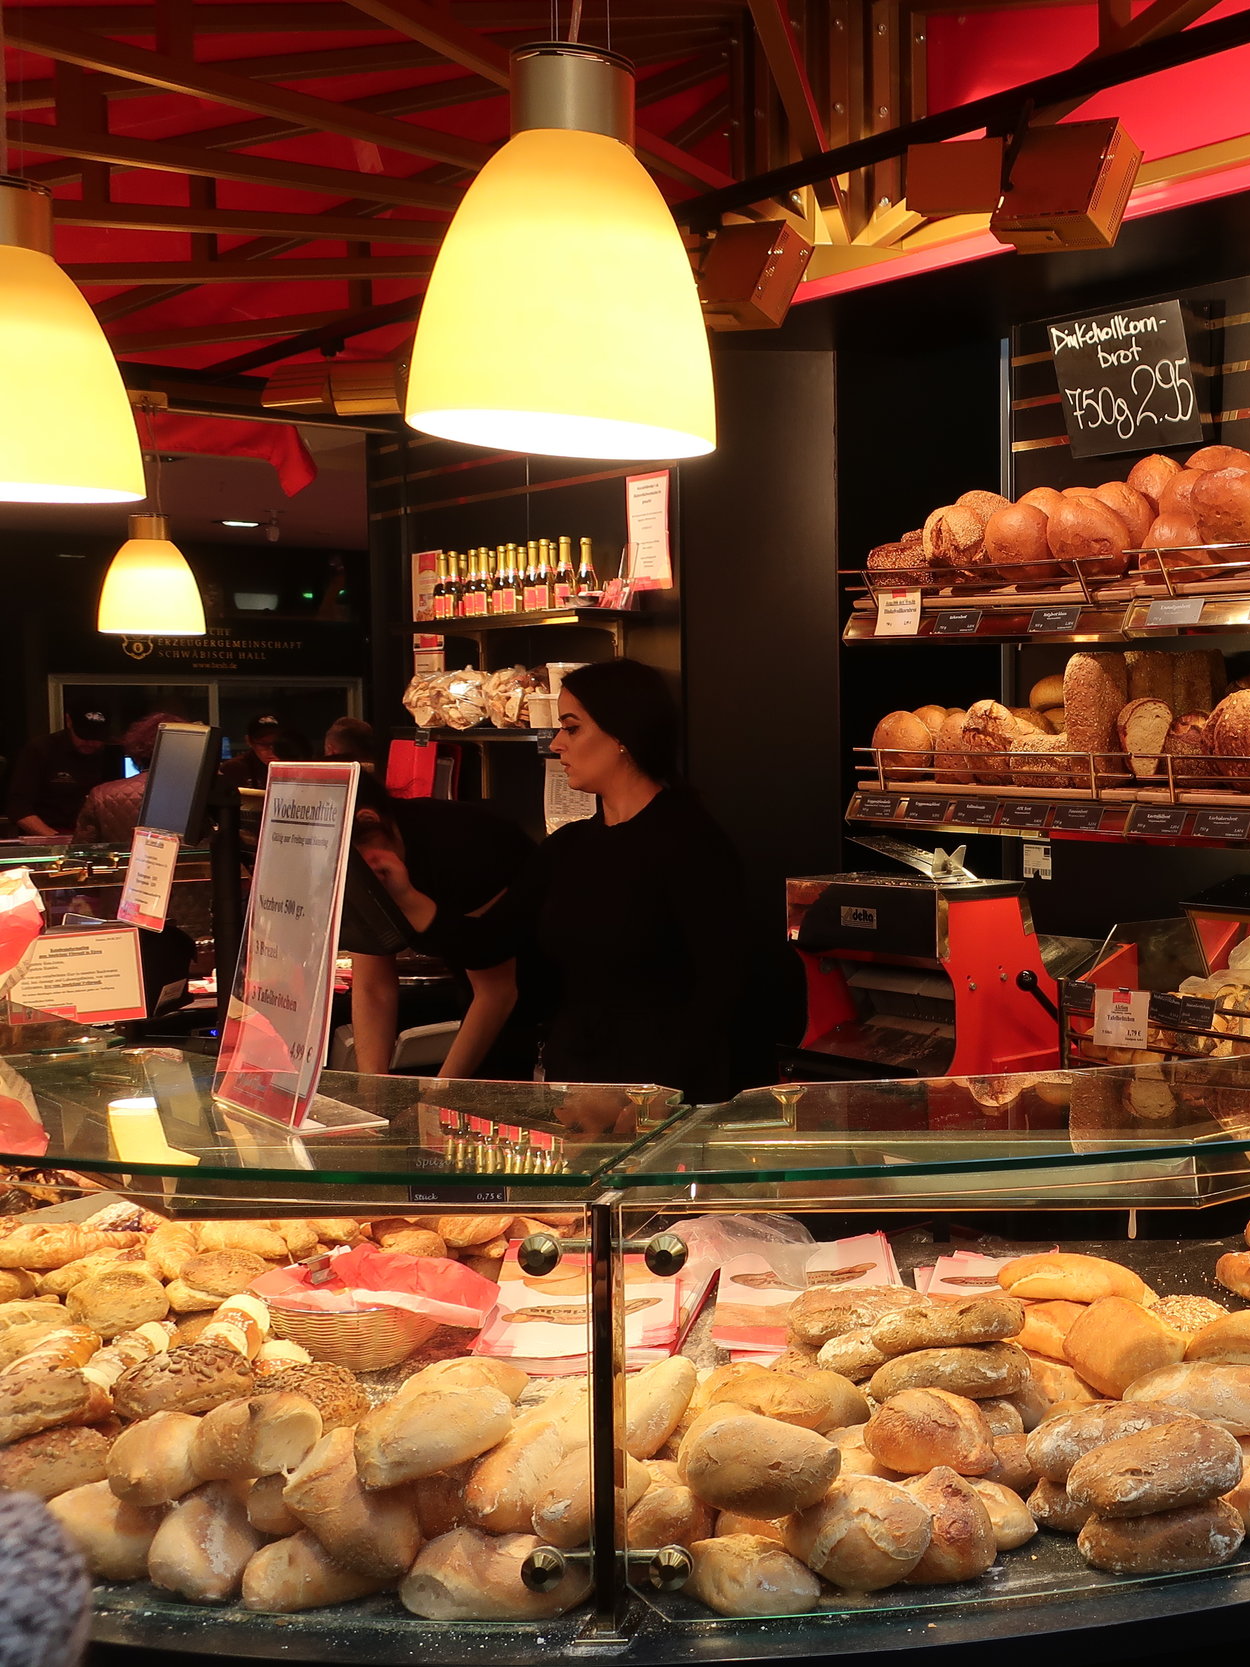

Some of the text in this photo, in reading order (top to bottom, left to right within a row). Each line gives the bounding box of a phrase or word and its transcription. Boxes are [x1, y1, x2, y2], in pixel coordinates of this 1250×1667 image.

[1097, 336, 1142, 368] brot
[157, 638, 303, 650] ERZEUGERGEMEINSCHAFT
[158, 649, 267, 661] SCHWÄBISCH HALL
[273, 797, 338, 822] Wochenendtüte
[284, 899, 296, 917] 500
[476, 1192, 495, 1201] 0,75
